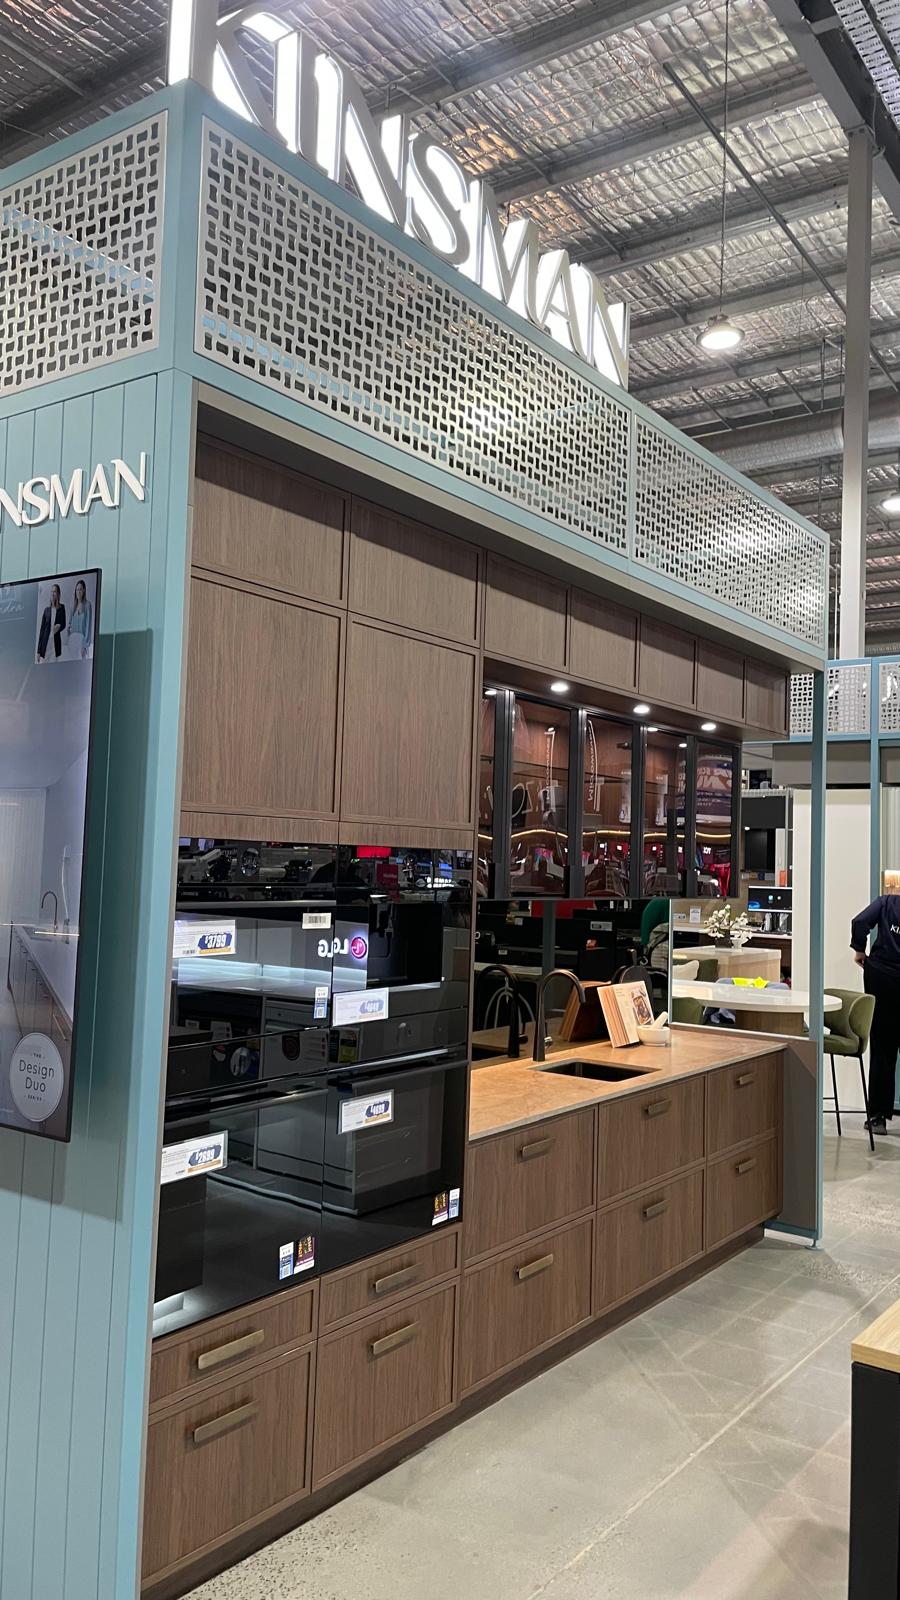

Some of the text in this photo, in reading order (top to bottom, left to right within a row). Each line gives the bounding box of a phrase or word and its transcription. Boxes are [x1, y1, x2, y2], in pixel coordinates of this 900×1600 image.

[167, 0, 631, 391] KINSMAN
[205, 934, 227, 949] $3799
[19, 1059, 55, 1079] Design
[25, 1077, 46, 1092] Duo
